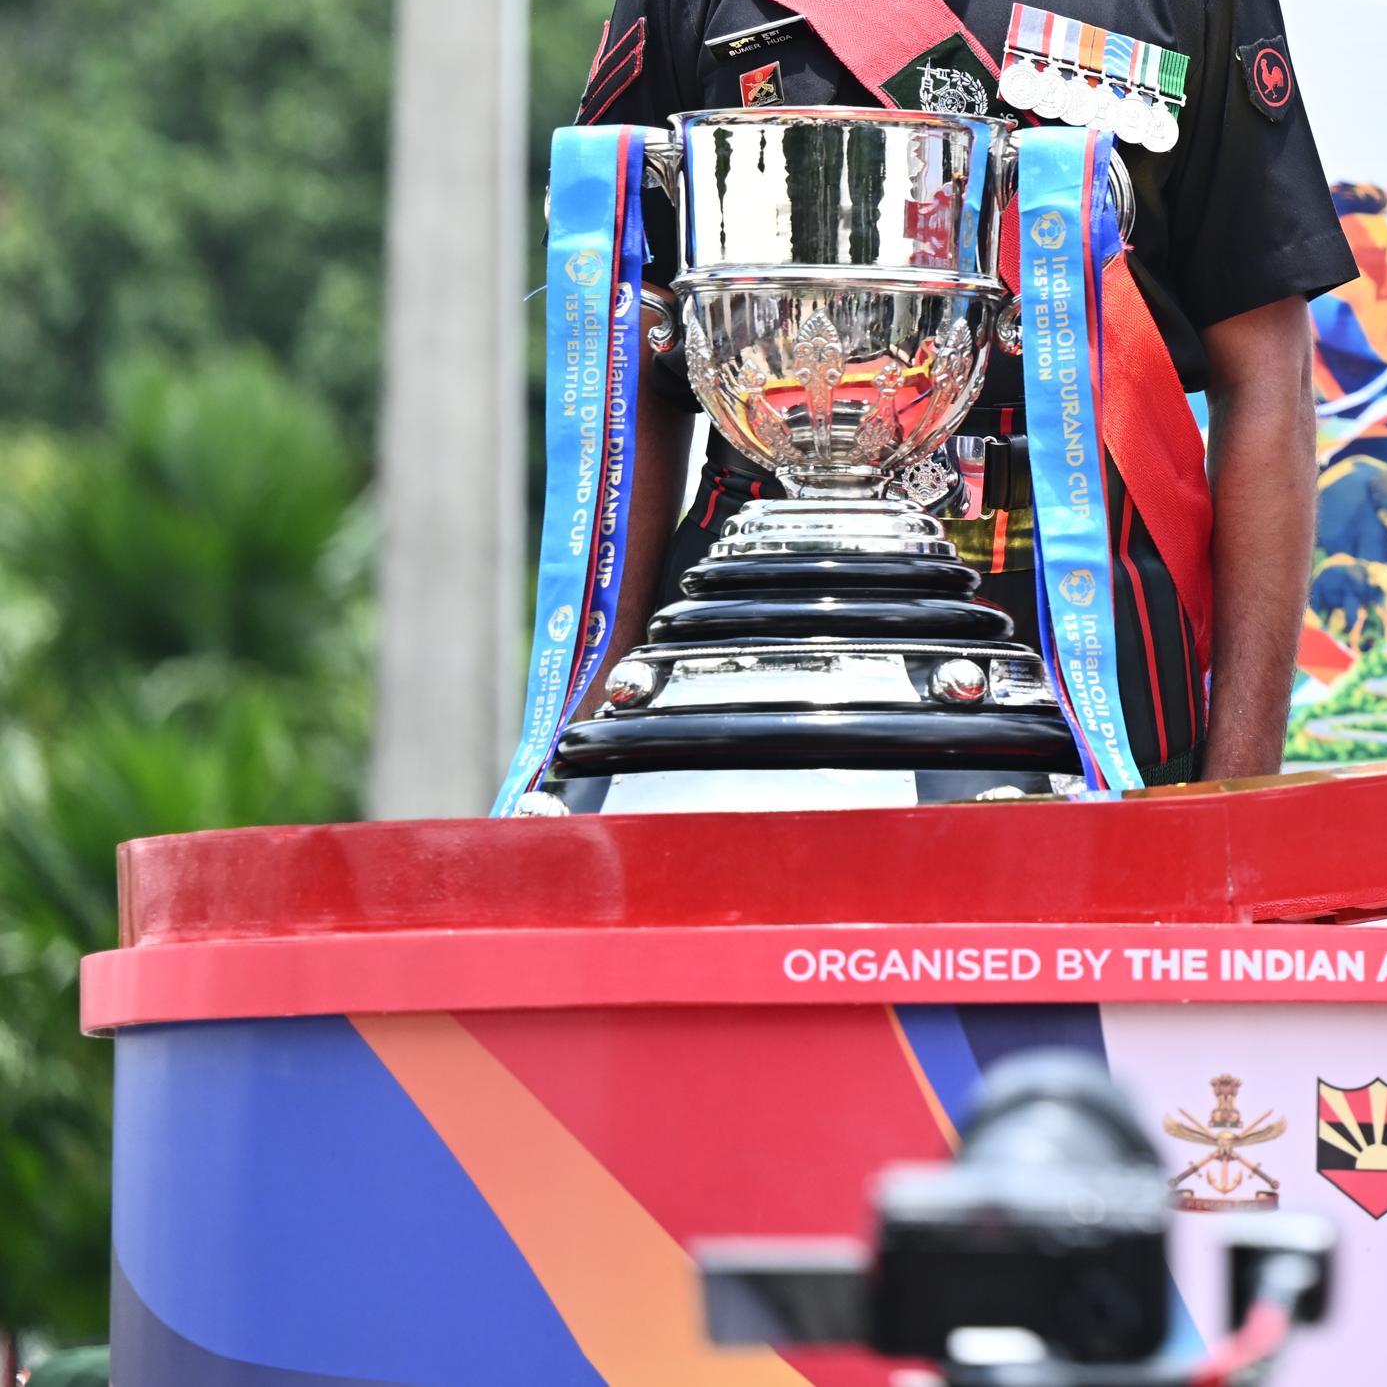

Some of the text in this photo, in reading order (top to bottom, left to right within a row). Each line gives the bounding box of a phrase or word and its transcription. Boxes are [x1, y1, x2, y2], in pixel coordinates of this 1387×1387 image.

[563, 341, 580, 417] EDITION
[1035, 304, 1053, 381] EDITION
[568, 294, 602, 556] IndianOil DURAND CUP
[1052, 256, 1091, 519] IndianOil DURAND CUP
[596, 324, 629, 589] IndianOil DURAND CUP
[517, 695, 545, 767] EDITION
[1070, 660, 1099, 732] EDITION
[1081, 615, 1139, 790] IndianOil DURA
[784, 948, 1041, 982] ORGANISED
[1057, 948, 1111, 981] BY
[1124, 949, 1208, 981] THE
[1221, 950, 1365, 982] INDIAN
